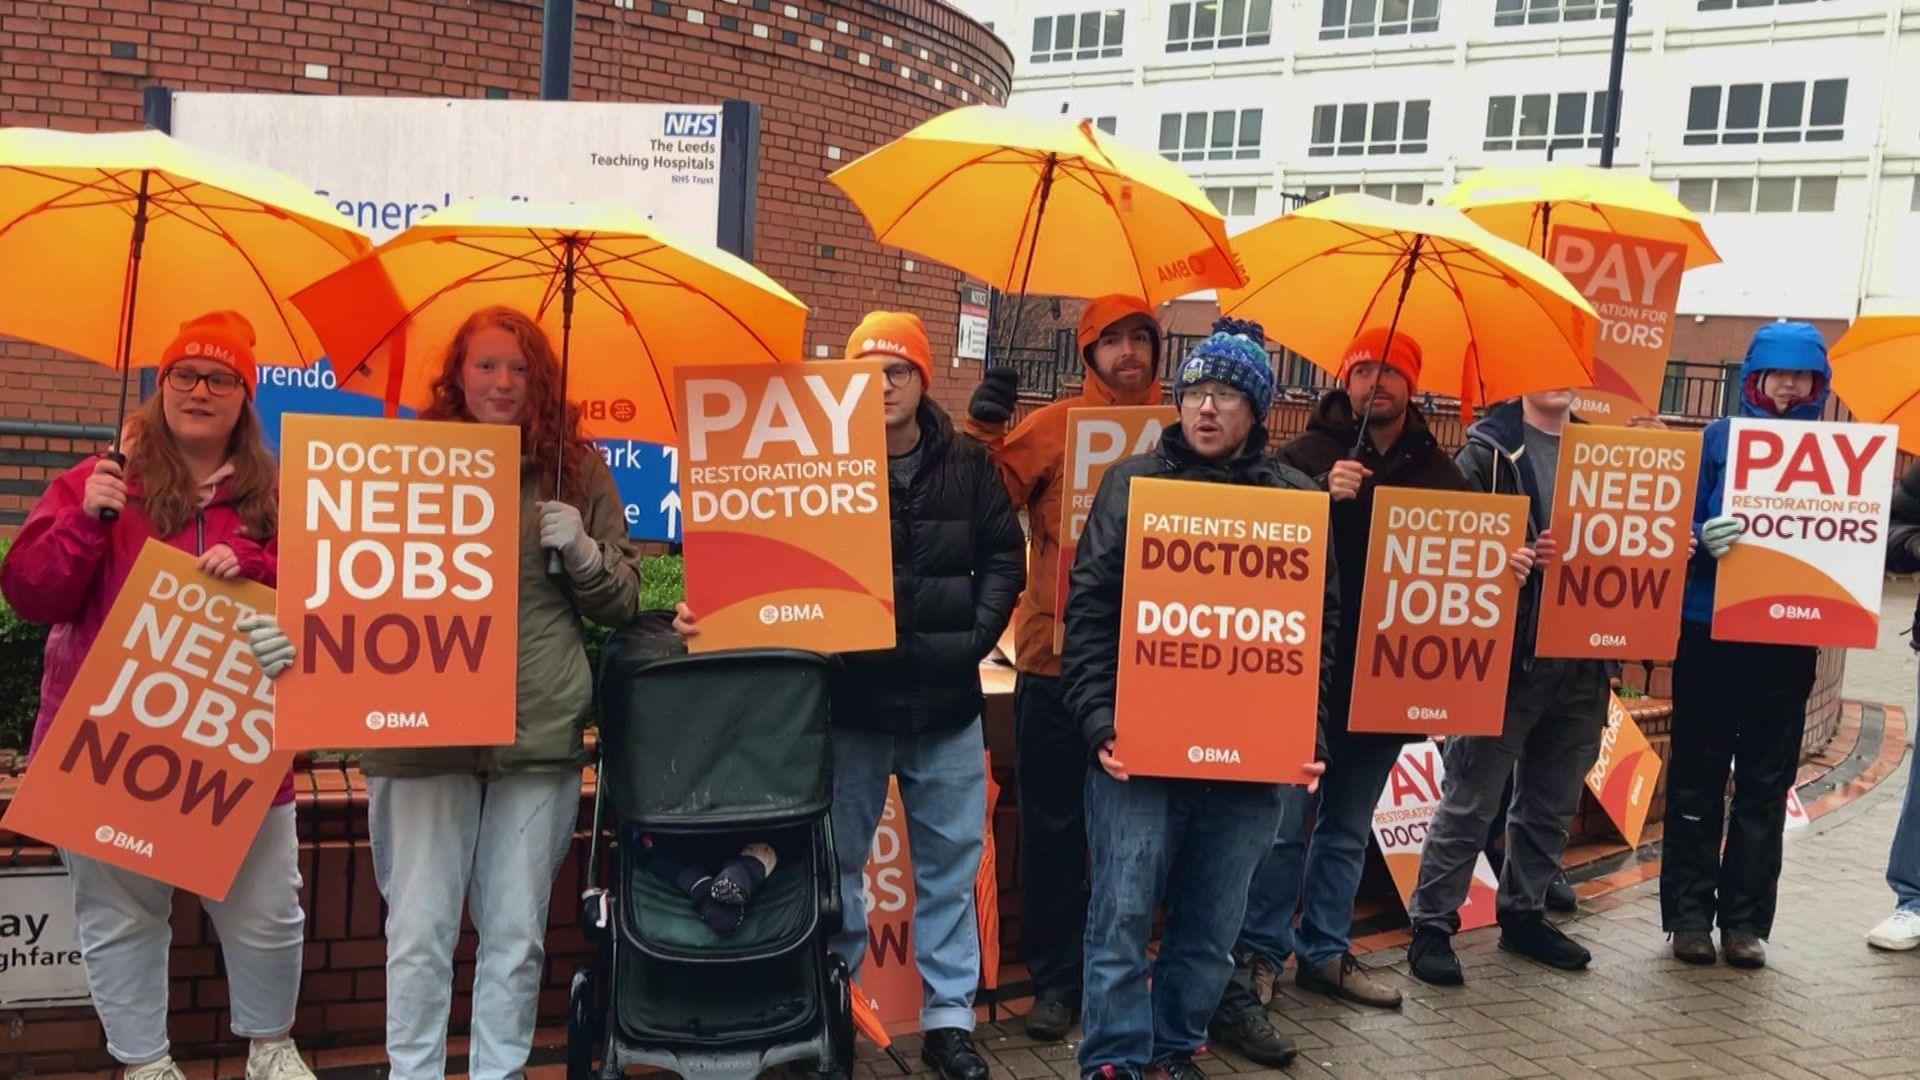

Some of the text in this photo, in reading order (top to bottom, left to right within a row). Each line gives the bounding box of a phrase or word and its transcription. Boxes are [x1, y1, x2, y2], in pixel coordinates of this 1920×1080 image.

[665, 114, 715, 135] NHS
[591, 153, 715, 172] Teaching Hospitals
[650, 139, 716, 154] The Leeds
[671, 175, 714, 185] NHS Trust
[1554, 235, 1678, 306] PAY
[1590, 301, 1668, 324] RATION FOR
[877, 338, 908, 354] BMA
[1600, 319, 1665, 349] TORS
[203, 343, 236, 366] BMA
[684, 373, 872, 462] PAY
[1581, 399, 1611, 414] BMA
[307, 440, 496, 479] DOCTORS
[690, 458, 877, 484] RESTORATION FOR
[1573, 443, 1686, 471] DOCTORS
[1734, 428, 1888, 496] PAY
[305, 478, 495, 536] NEED
[692, 481, 879, 522] DOCTORS
[1568, 469, 1682, 512] NEED
[1731, 494, 1881, 515] RESTORATION FOR
[1143, 513, 1312, 544] PATIENTS NEED
[1388, 505, 1512, 536] DOCTORS
[1562, 513, 1677, 562] JOBS
[305, 538, 494, 610] JOBS
[1141, 536, 1310, 582] DOCTORS
[1383, 535, 1508, 579] NEED
[148, 570, 257, 632] DOCT
[1556, 564, 1671, 610] NOW
[781, 603, 825, 622] BMA
[1136, 599, 1307, 645] DOCTORS
[1377, 579, 1503, 631] JOBS
[1786, 604, 1821, 620] BMA
[302, 613, 493, 675] NOW
[1601, 633, 1628, 646] BMA
[1134, 639, 1305, 677] NEED JOBS
[1371, 633, 1497, 682] NOW
[89, 658, 274, 764] JOBS
[386, 711, 430, 729] BMA
[1420, 707, 1448, 720] BMA
[1205, 747, 1241, 764] BMA
[1589, 704, 1625, 792] DOCTORS
[59, 718, 255, 828] NOW
[1388, 751, 1442, 807] AY
[112, 835, 155, 859] BMA
[1380, 821, 1429, 848] DOCT
